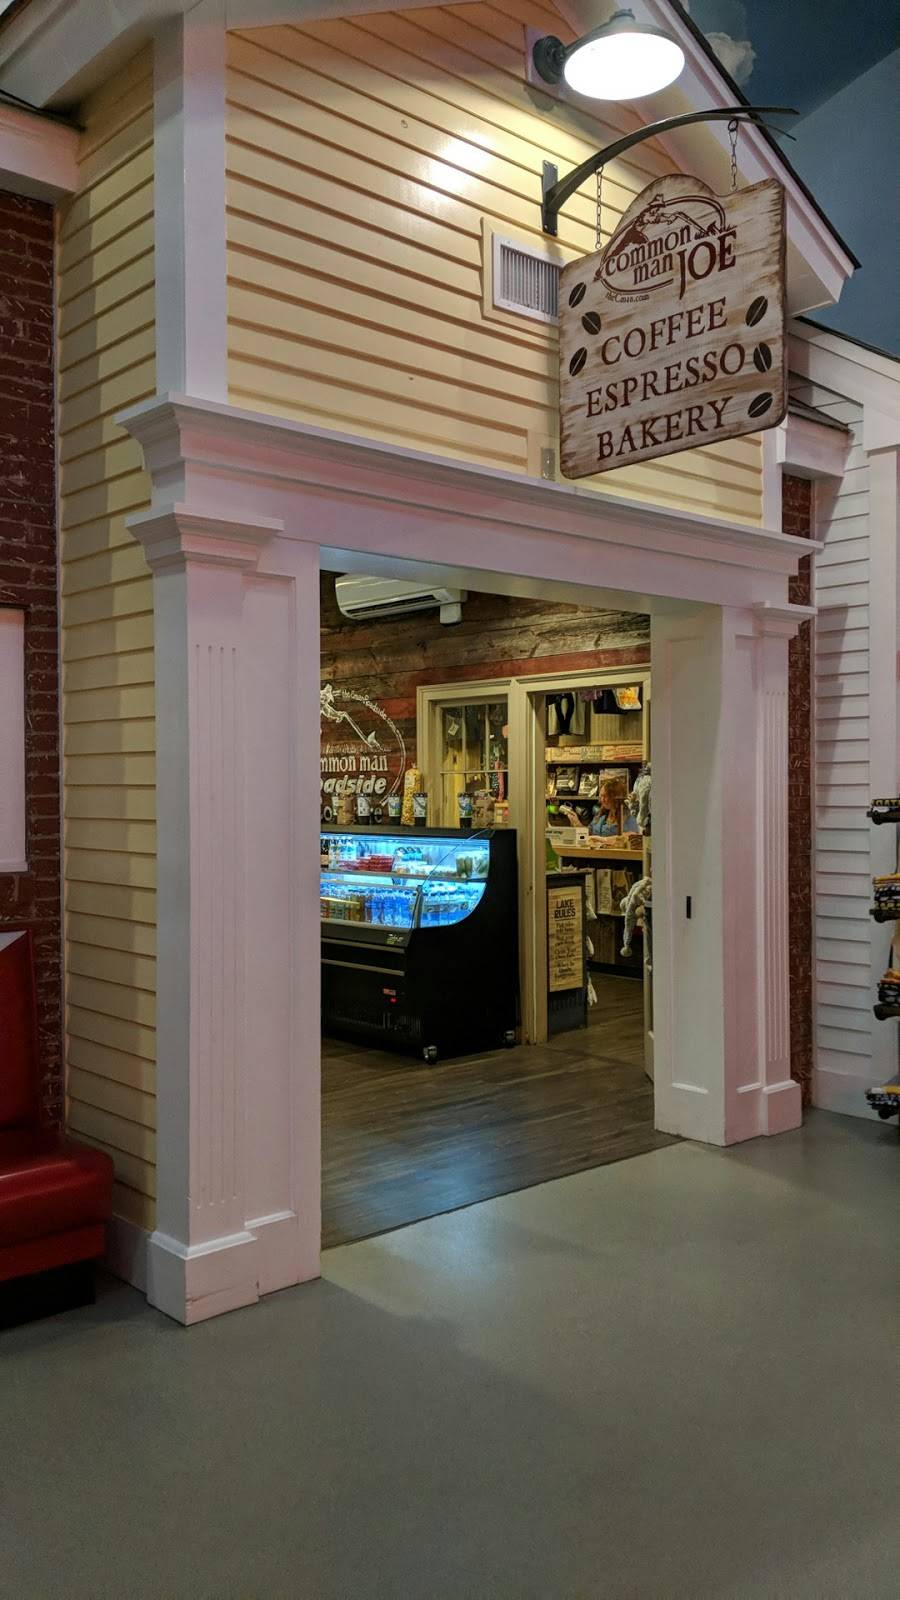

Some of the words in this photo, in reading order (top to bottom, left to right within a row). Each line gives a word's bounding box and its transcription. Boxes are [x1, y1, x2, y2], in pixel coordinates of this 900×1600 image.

[604, 224, 692, 276] common
[633, 252, 674, 285] man
[679, 231, 737, 300] JOE
[601, 297, 728, 367] COFFEE
[586, 342, 746, 418] ESPRESSO
[597, 396, 733, 461] BAKERY
[320, 755, 356, 772] mmon
[360, 755, 388, 772] man
[320, 775, 387, 794] adside
[554, 909, 576, 919] RULES
[556, 899, 575, 909] LAKE
